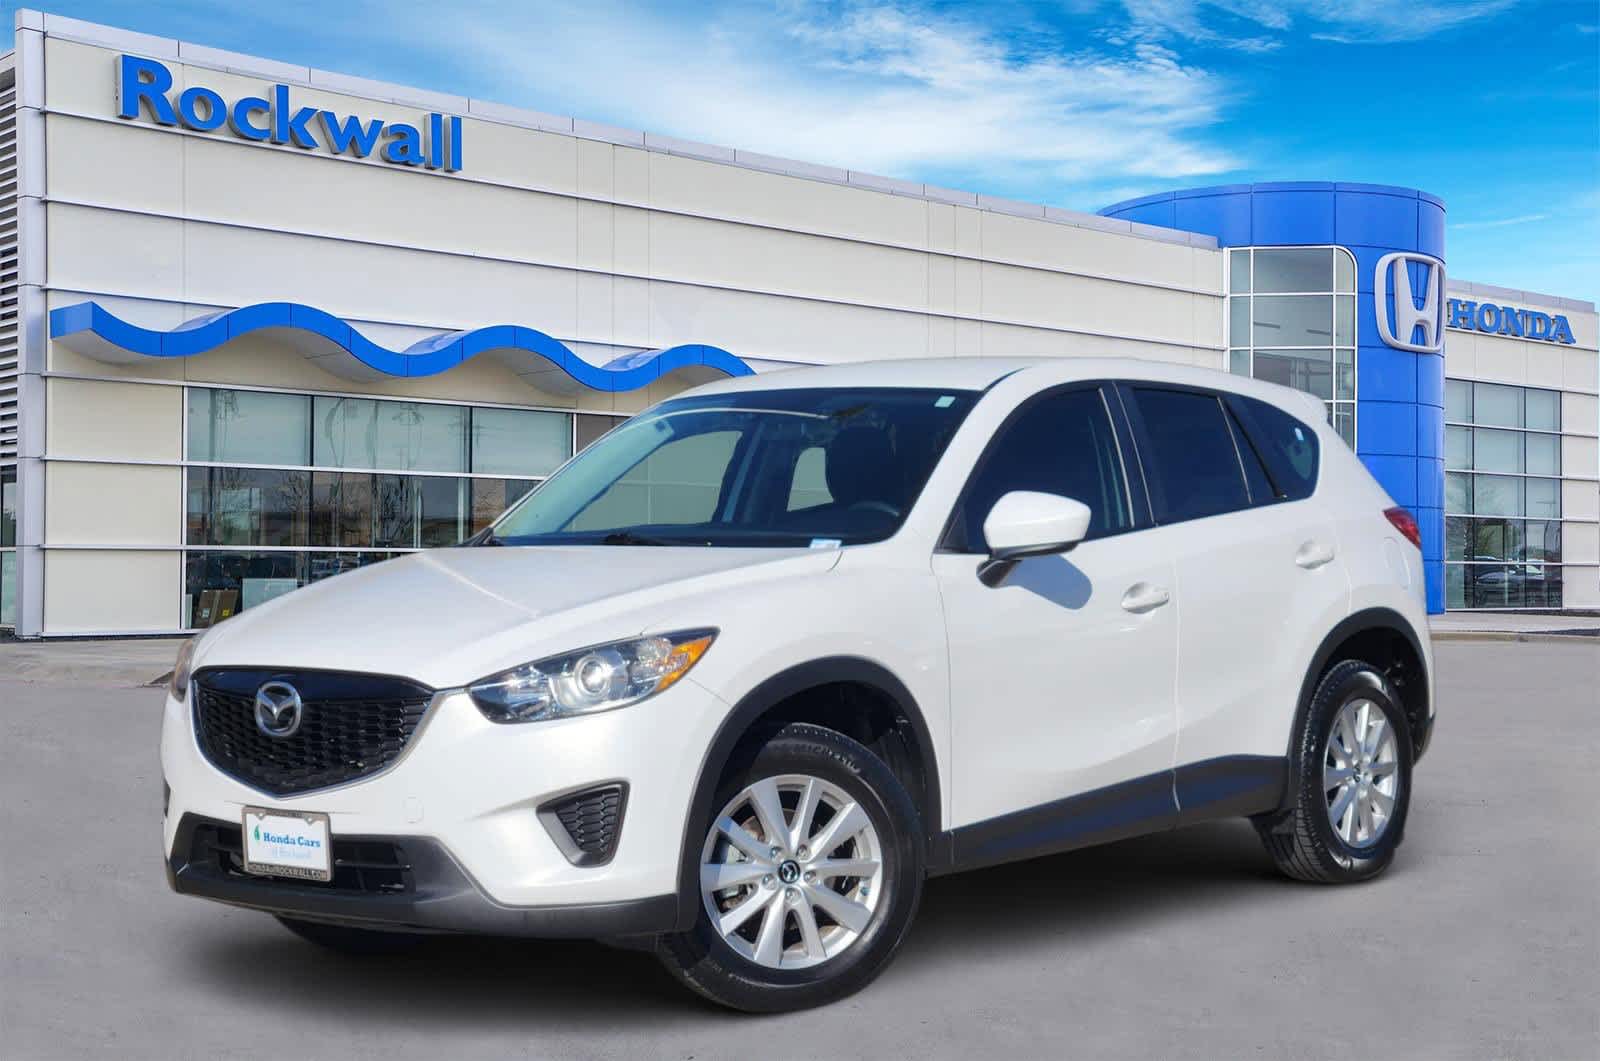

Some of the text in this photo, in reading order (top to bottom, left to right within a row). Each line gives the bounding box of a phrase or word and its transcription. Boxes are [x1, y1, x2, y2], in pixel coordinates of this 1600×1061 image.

[116, 54, 462, 172] Rockwall
[1447, 298, 1576, 344] HONDA
[263, 832, 321, 848] Honda Cars
